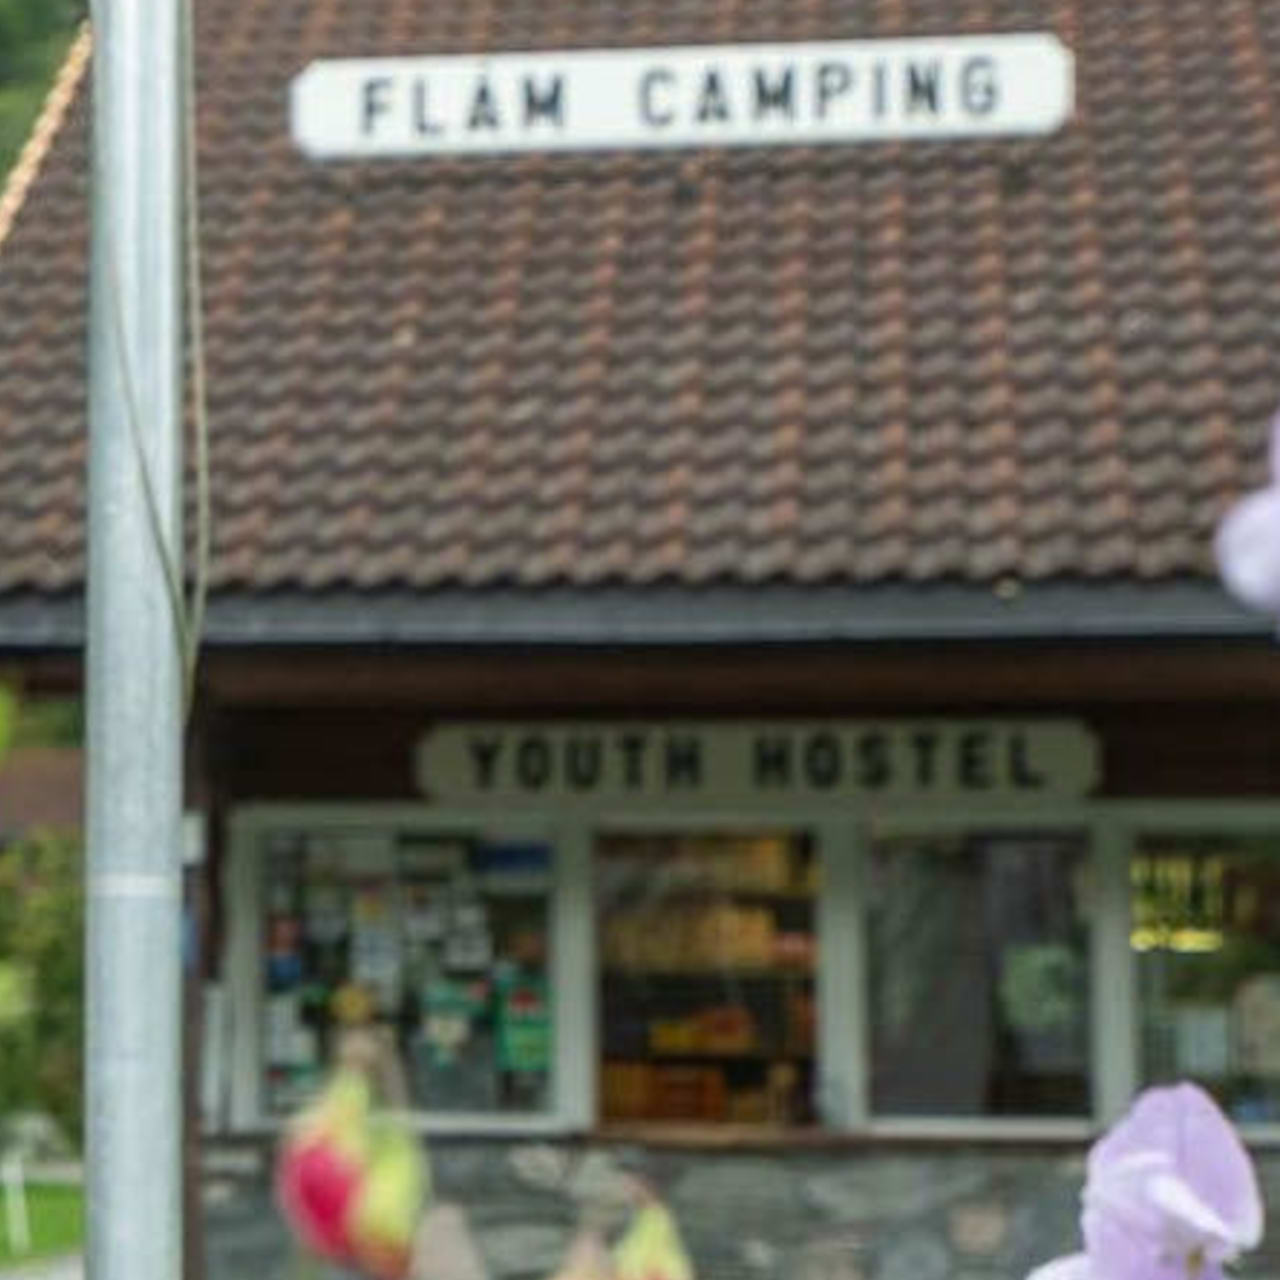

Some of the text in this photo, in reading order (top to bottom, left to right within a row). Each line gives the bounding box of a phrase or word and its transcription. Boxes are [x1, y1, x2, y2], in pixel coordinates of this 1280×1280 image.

[638, 56, 1000, 128] CAMPING
[466, 729, 1047, 792] YOUTH HOSTEL
